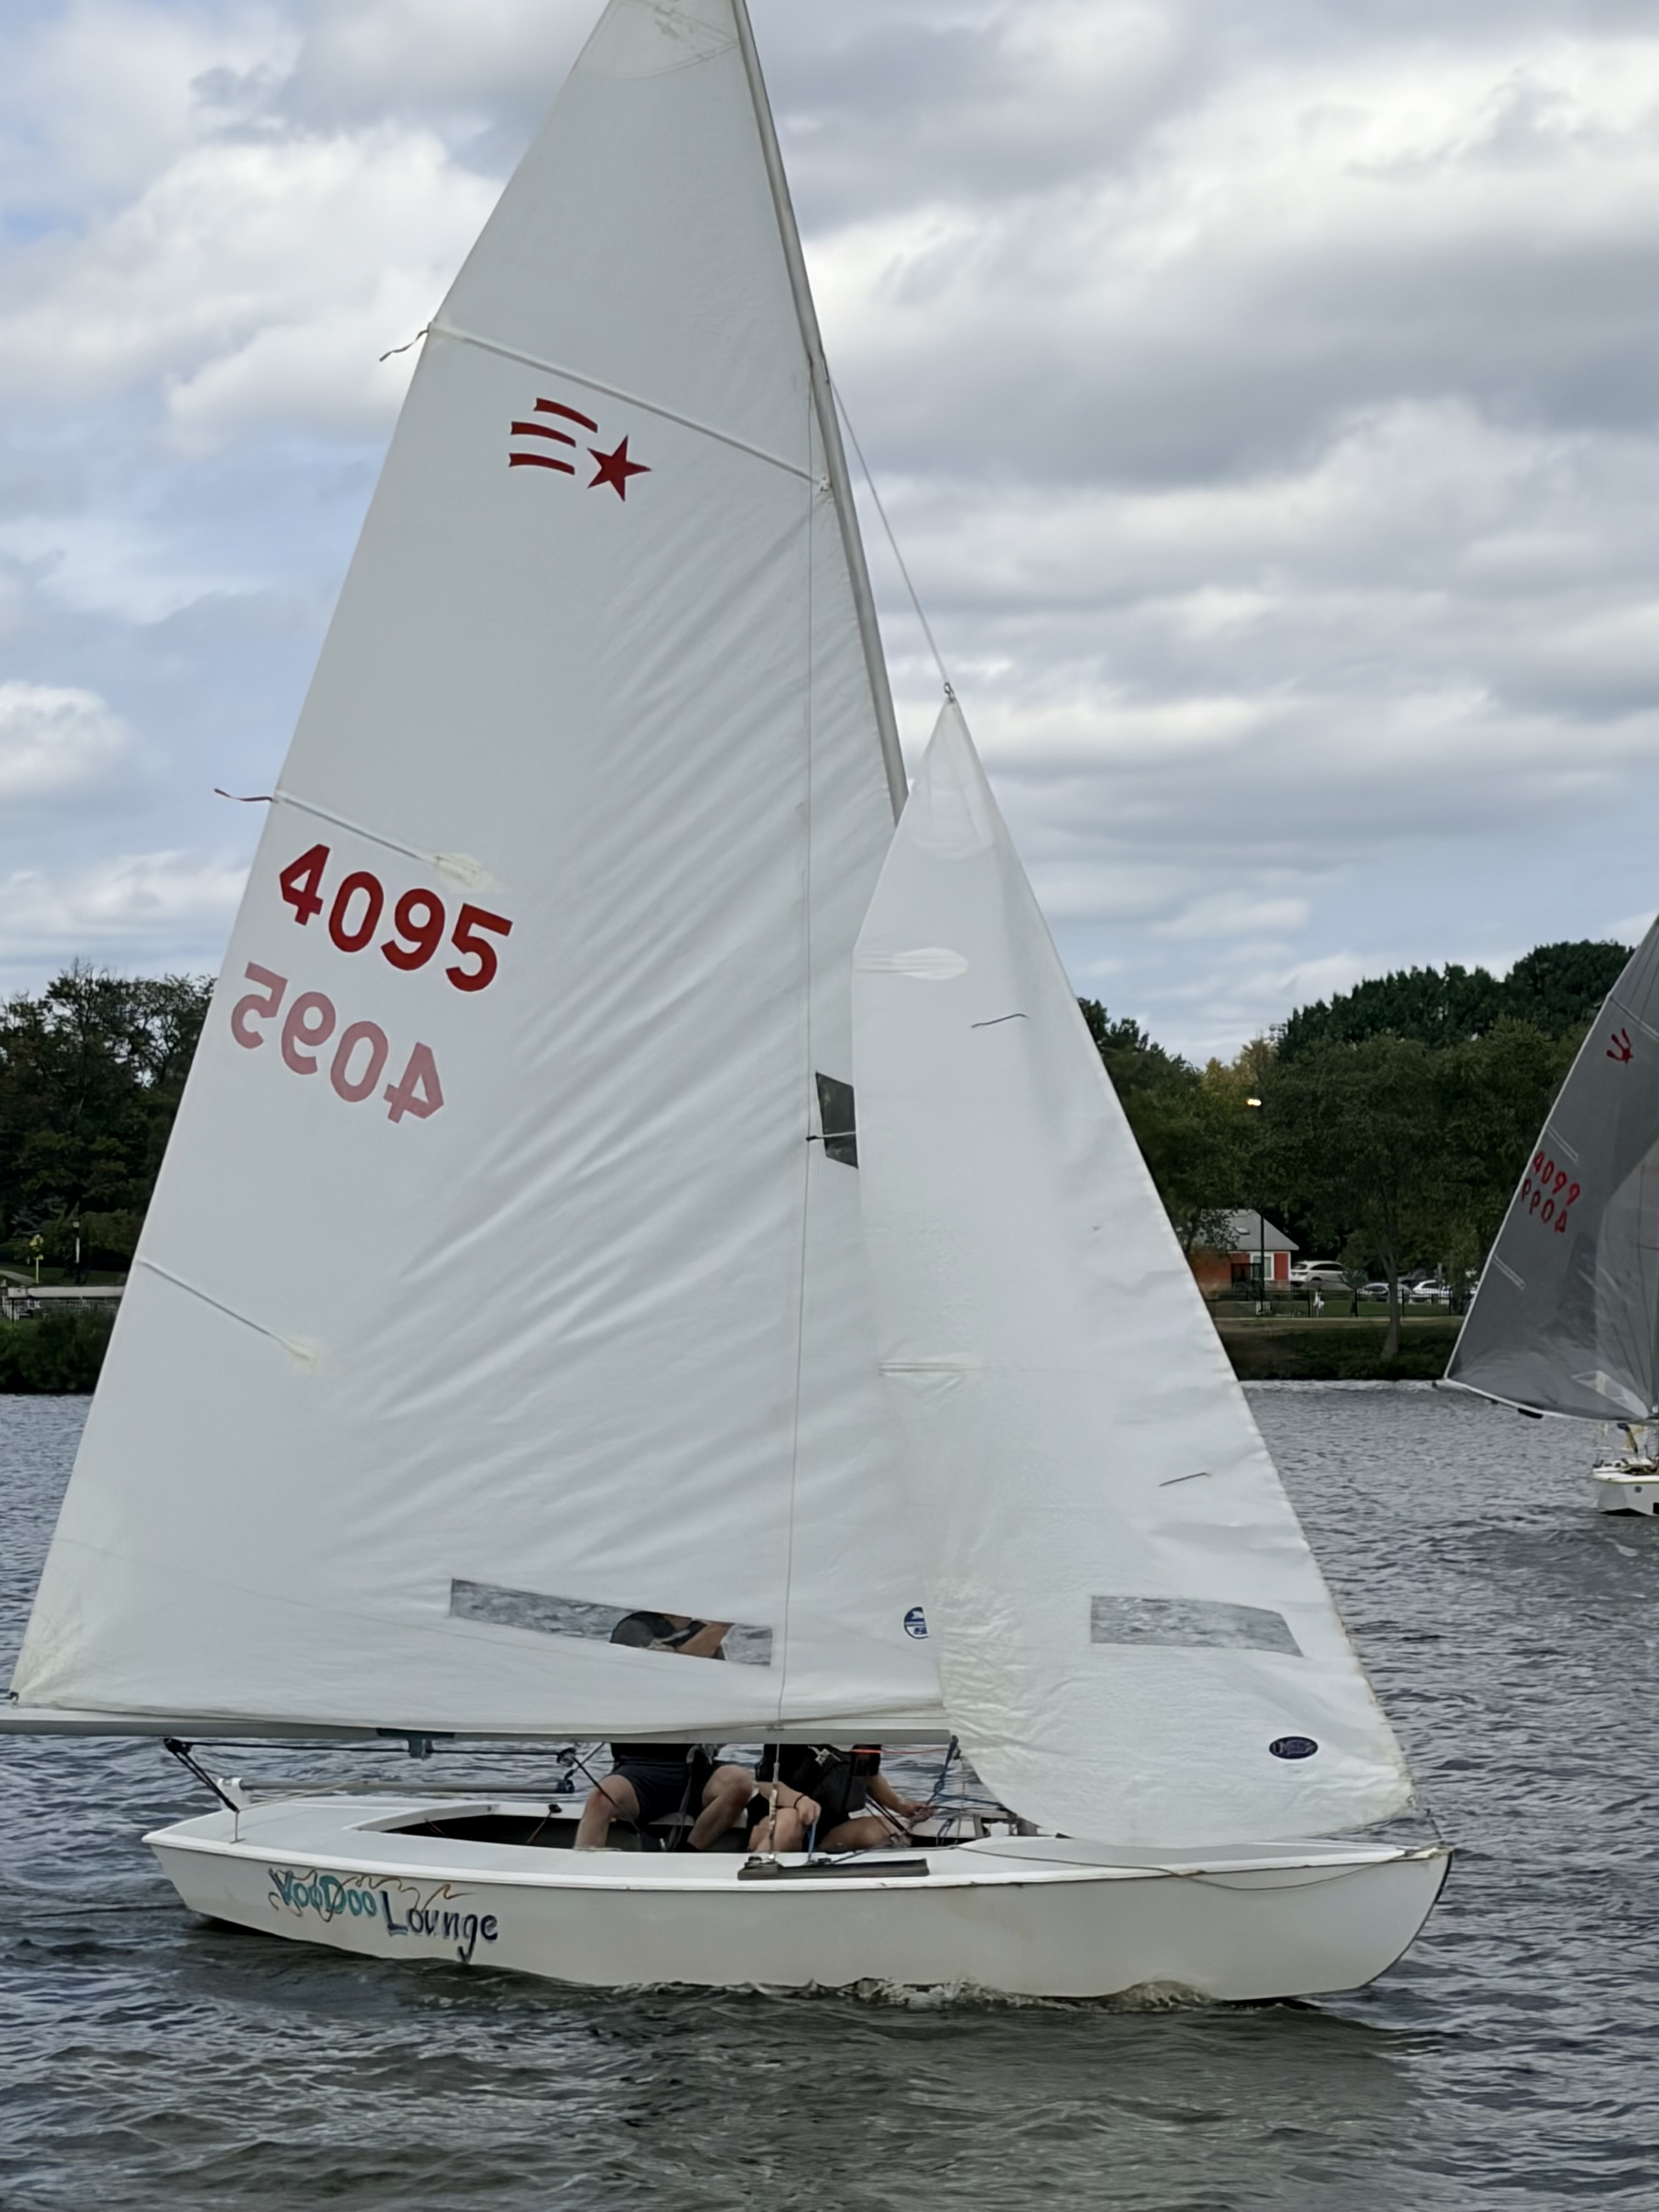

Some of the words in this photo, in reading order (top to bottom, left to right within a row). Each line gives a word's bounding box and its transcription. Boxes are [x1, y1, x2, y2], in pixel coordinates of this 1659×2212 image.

[279, 844, 513, 992] 4095
[1533, 1150, 1580, 1206] 4099
[380, 1891, 498, 1963] Lounge
